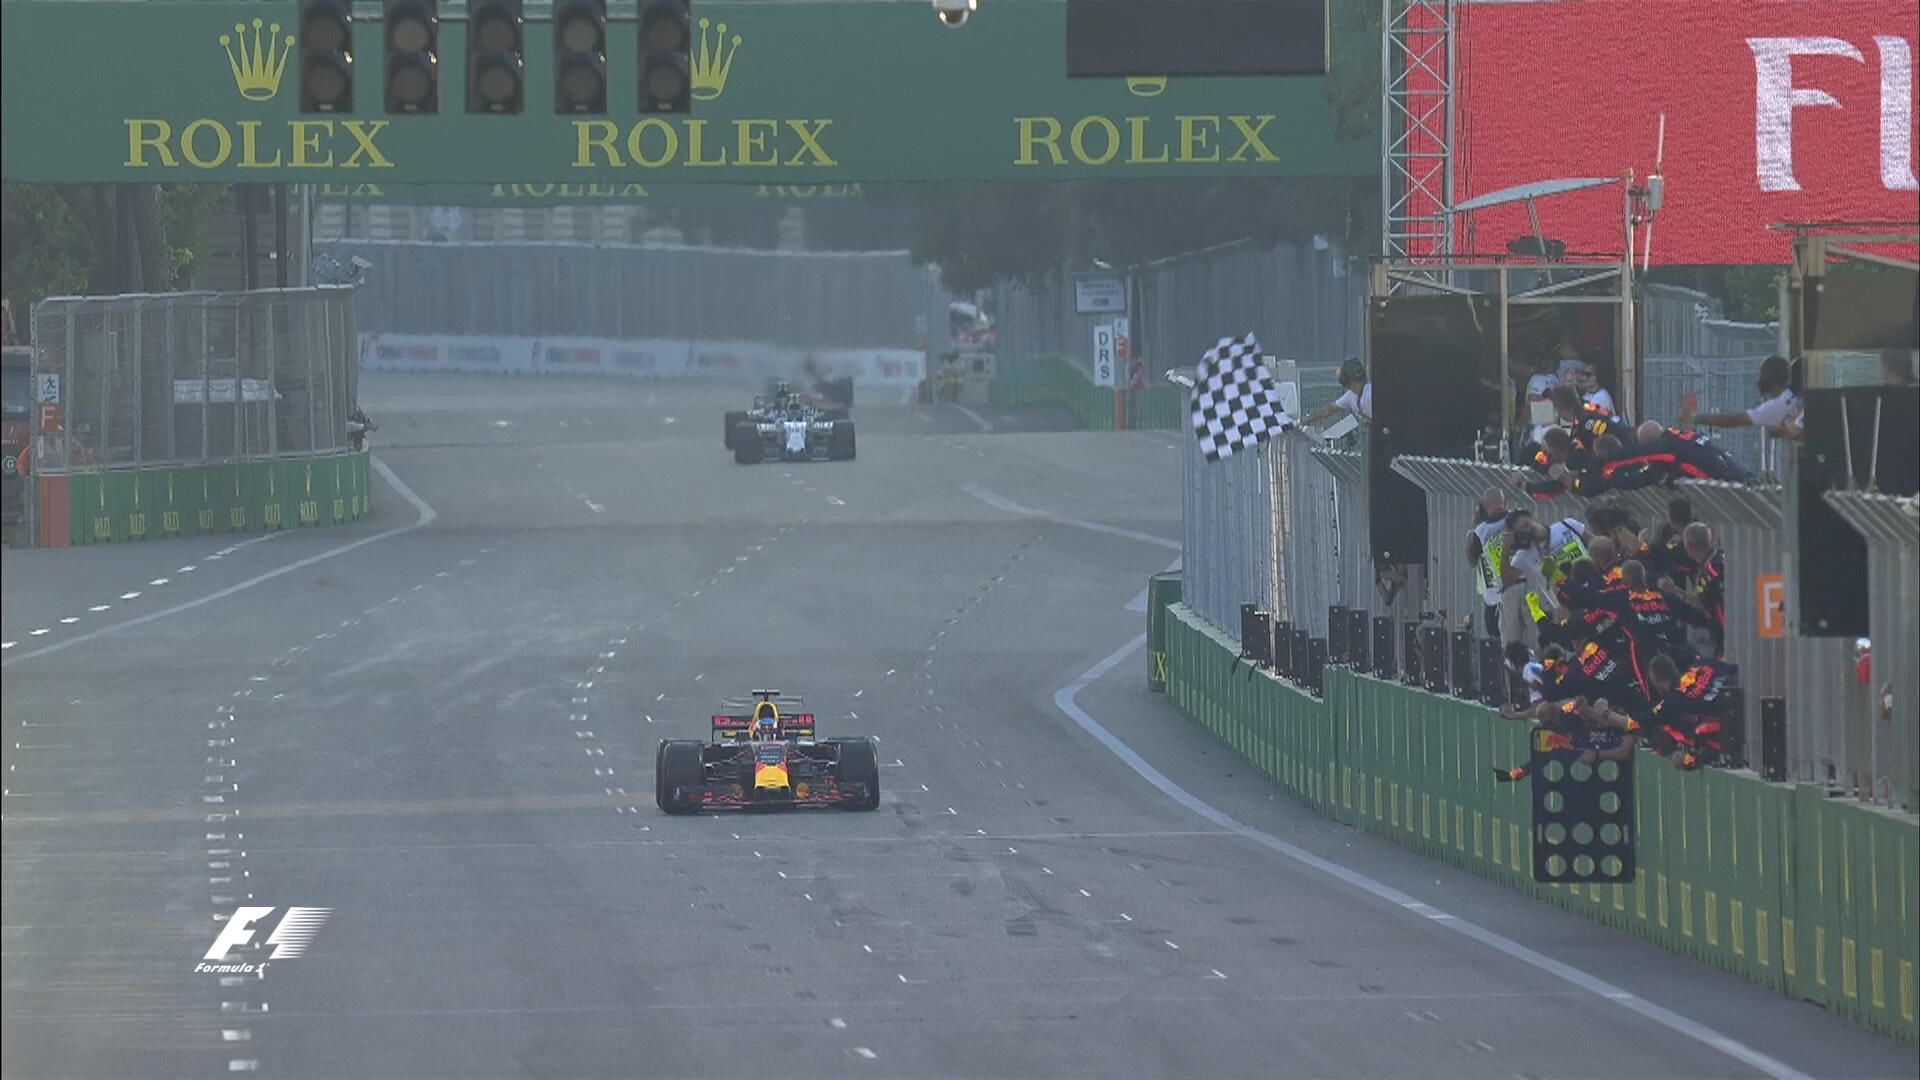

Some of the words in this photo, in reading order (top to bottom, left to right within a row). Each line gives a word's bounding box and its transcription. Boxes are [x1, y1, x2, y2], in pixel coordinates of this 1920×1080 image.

[123, 118, 395, 168] ROLEX
[571, 118, 838, 168] ROLEX
[1013, 114, 1279, 165] ROLEX
[1097, 331, 1110, 379] DRS
[41, 405, 56, 429] F
[1763, 582, 1783, 629] F
